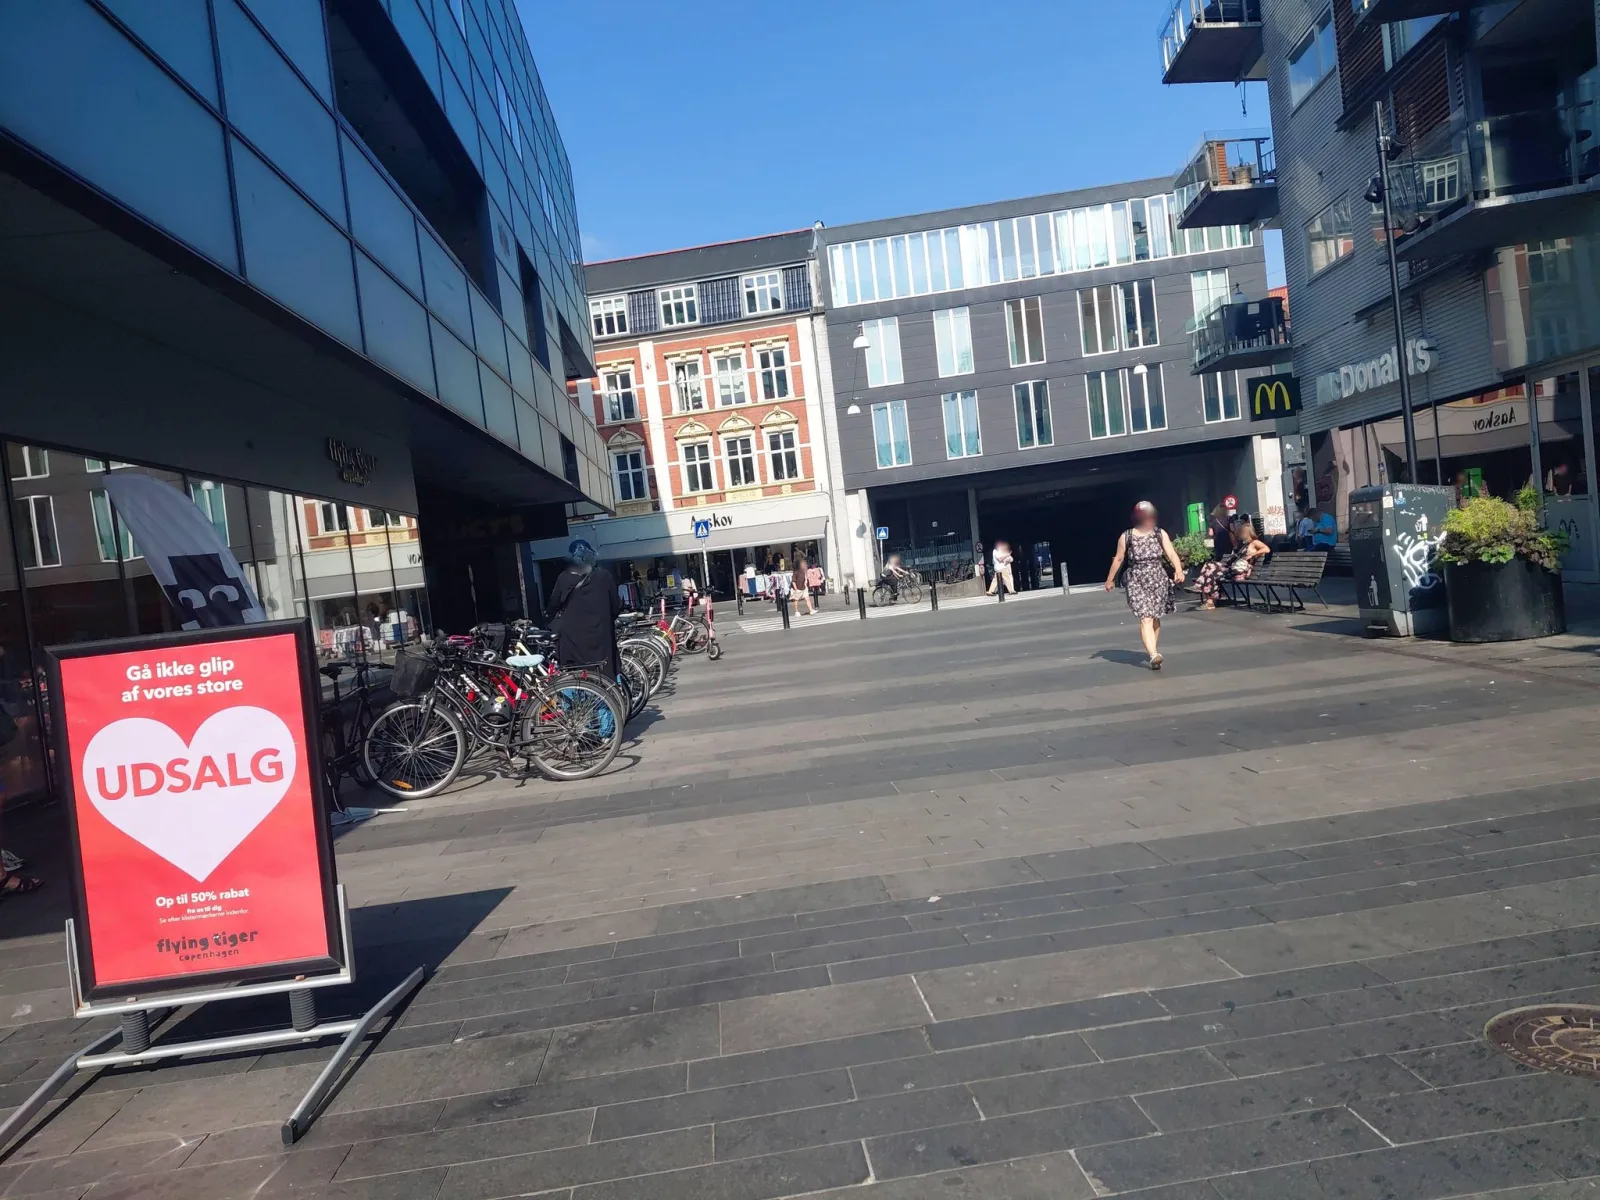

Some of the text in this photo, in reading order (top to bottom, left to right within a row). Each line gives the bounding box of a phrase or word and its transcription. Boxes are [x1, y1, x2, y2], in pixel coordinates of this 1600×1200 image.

[1316, 338, 1431, 404] McDonal's
[690, 513, 733, 530] Askov
[126, 656, 235, 681] Gå ikke glip
[121, 679, 243, 703] af vores store
[96, 748, 284, 800] UDSALG
[155, 888, 250, 908] Op til 50% rabat
[157, 930, 258, 954] flying tiger
[179, 949, 239, 961] copenhagen
